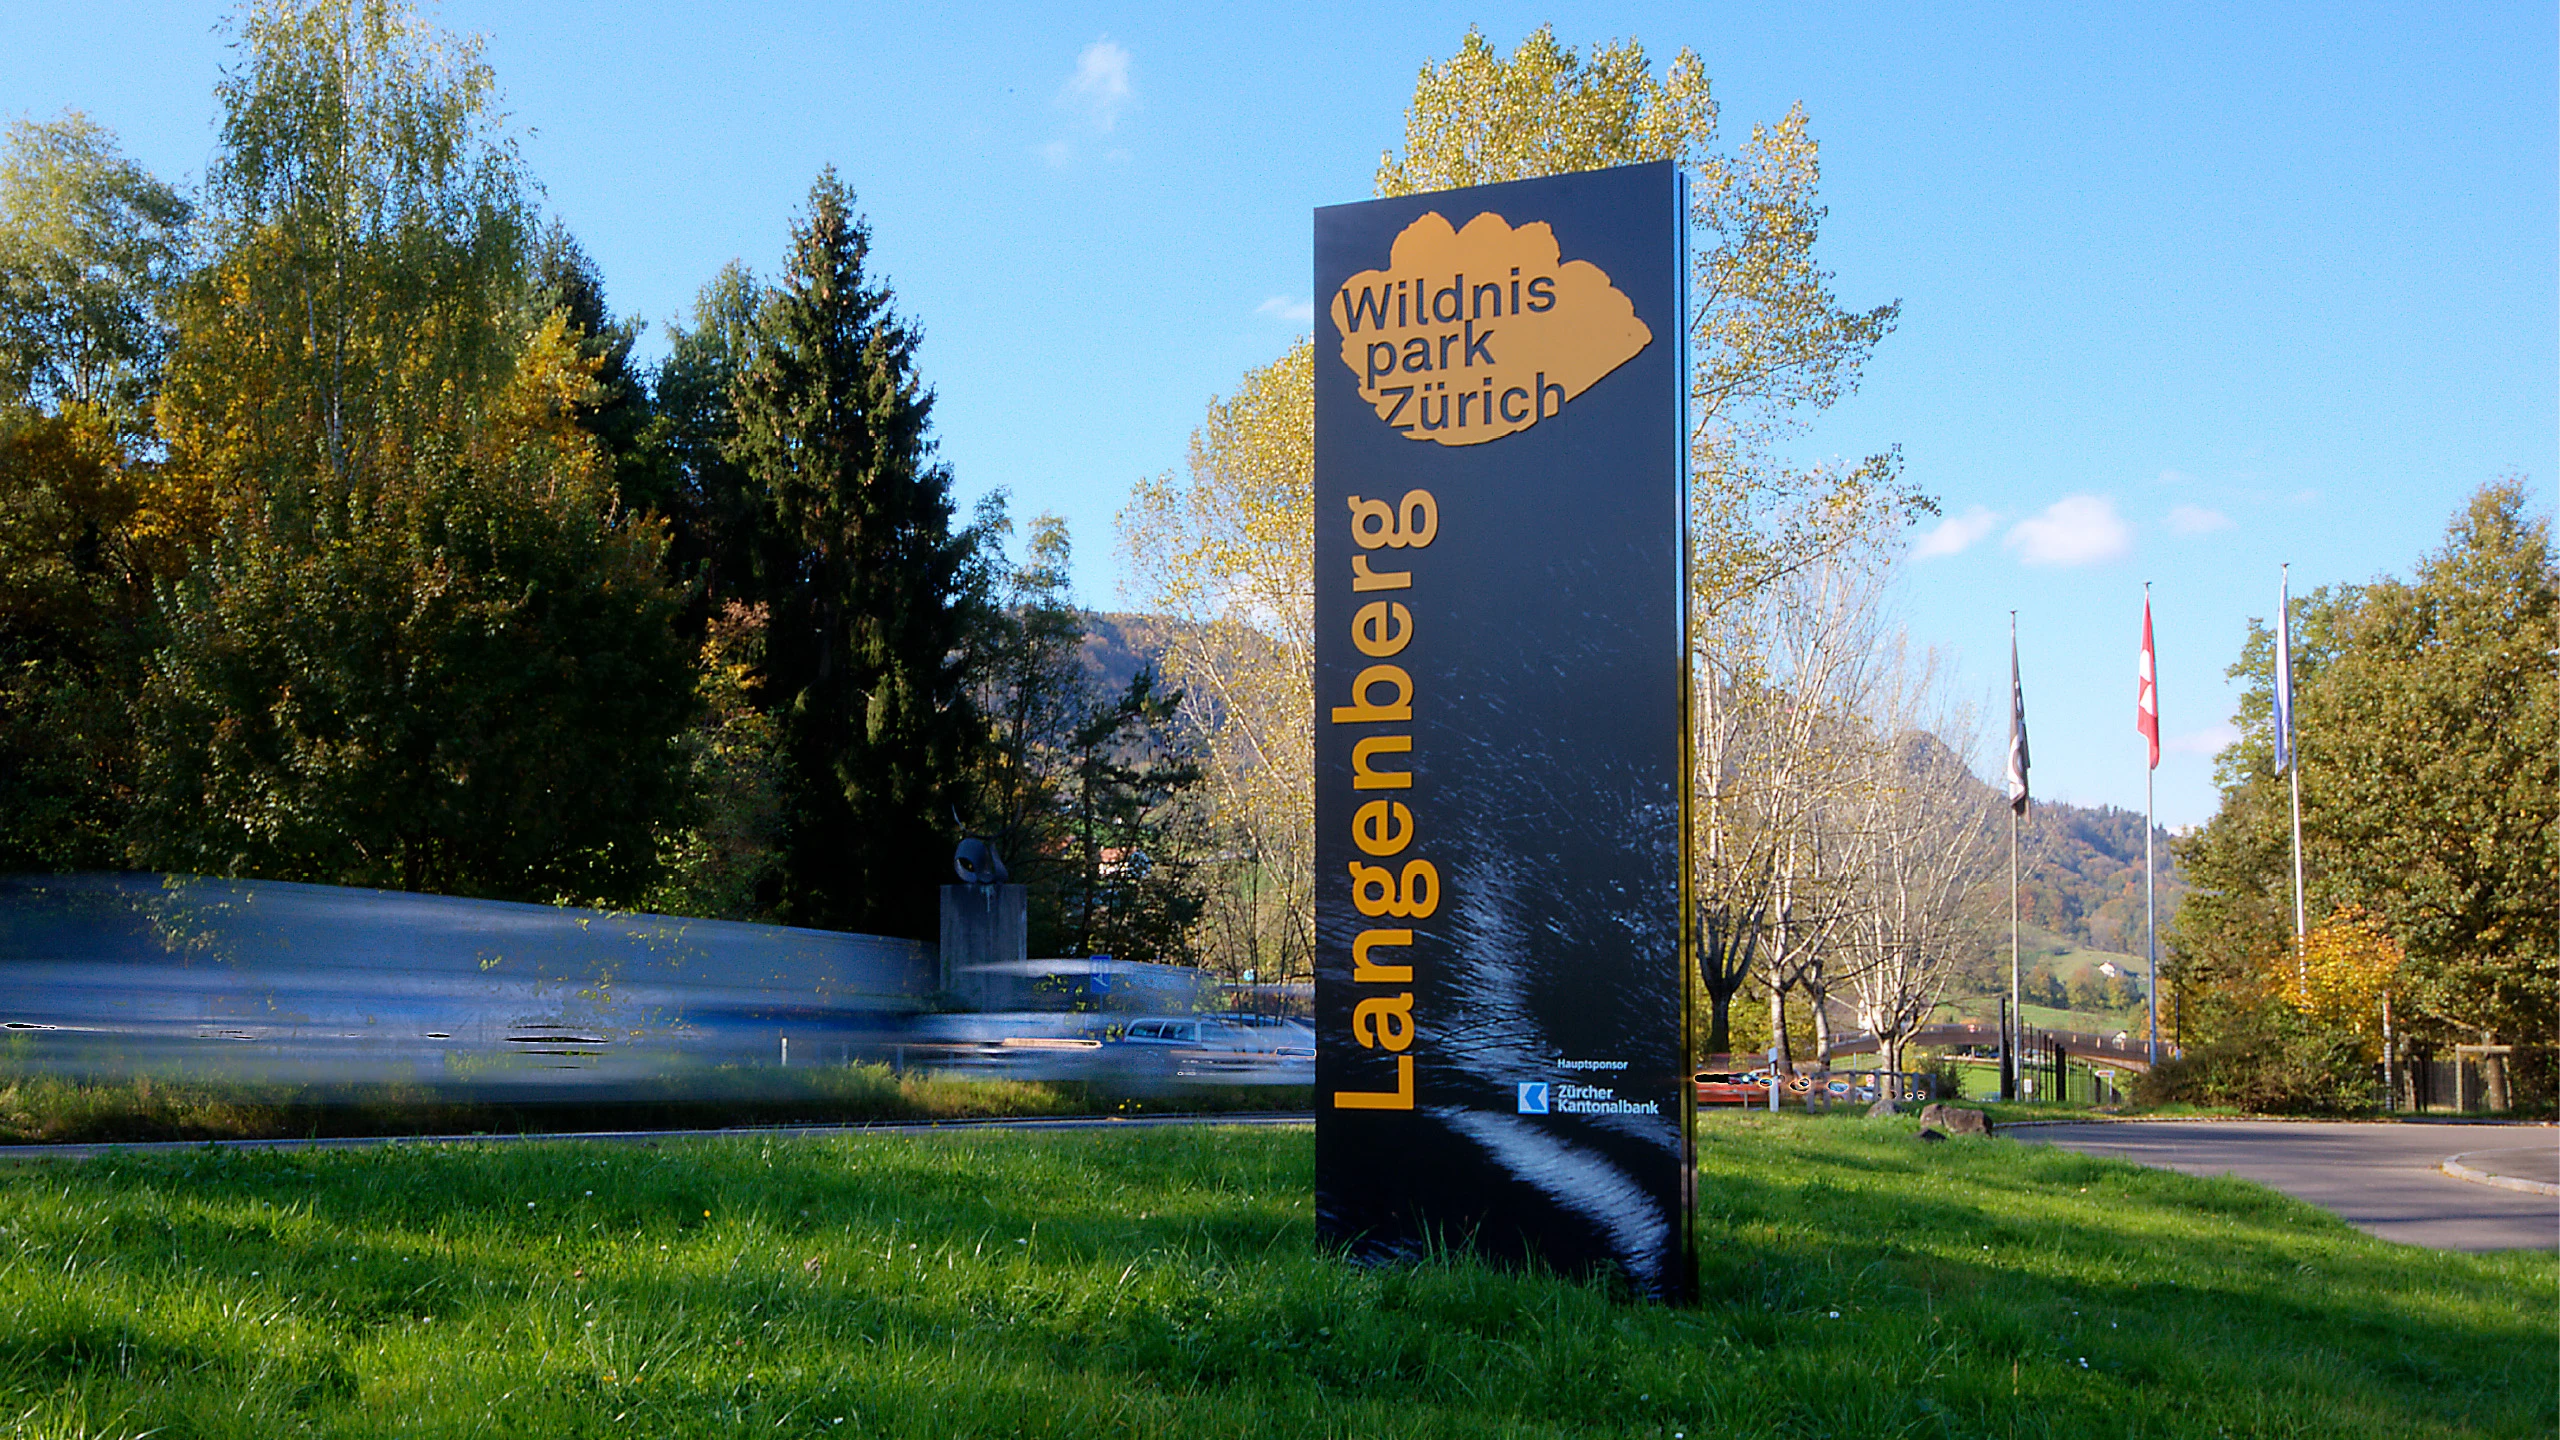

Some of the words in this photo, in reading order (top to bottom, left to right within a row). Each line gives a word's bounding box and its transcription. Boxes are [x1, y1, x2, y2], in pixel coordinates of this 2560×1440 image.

[1341, 266, 1556, 333] Wildnis
[1366, 319, 1495, 390] park
[1380, 372, 1566, 432] Zürich
[1332, 488, 1440, 1110] Langenberg
[1557, 1058, 1629, 1071] Hauptsponsor
[1558, 1084, 1614, 1099] Zürcher
[1557, 1099, 1660, 1115] Kantonalbank
